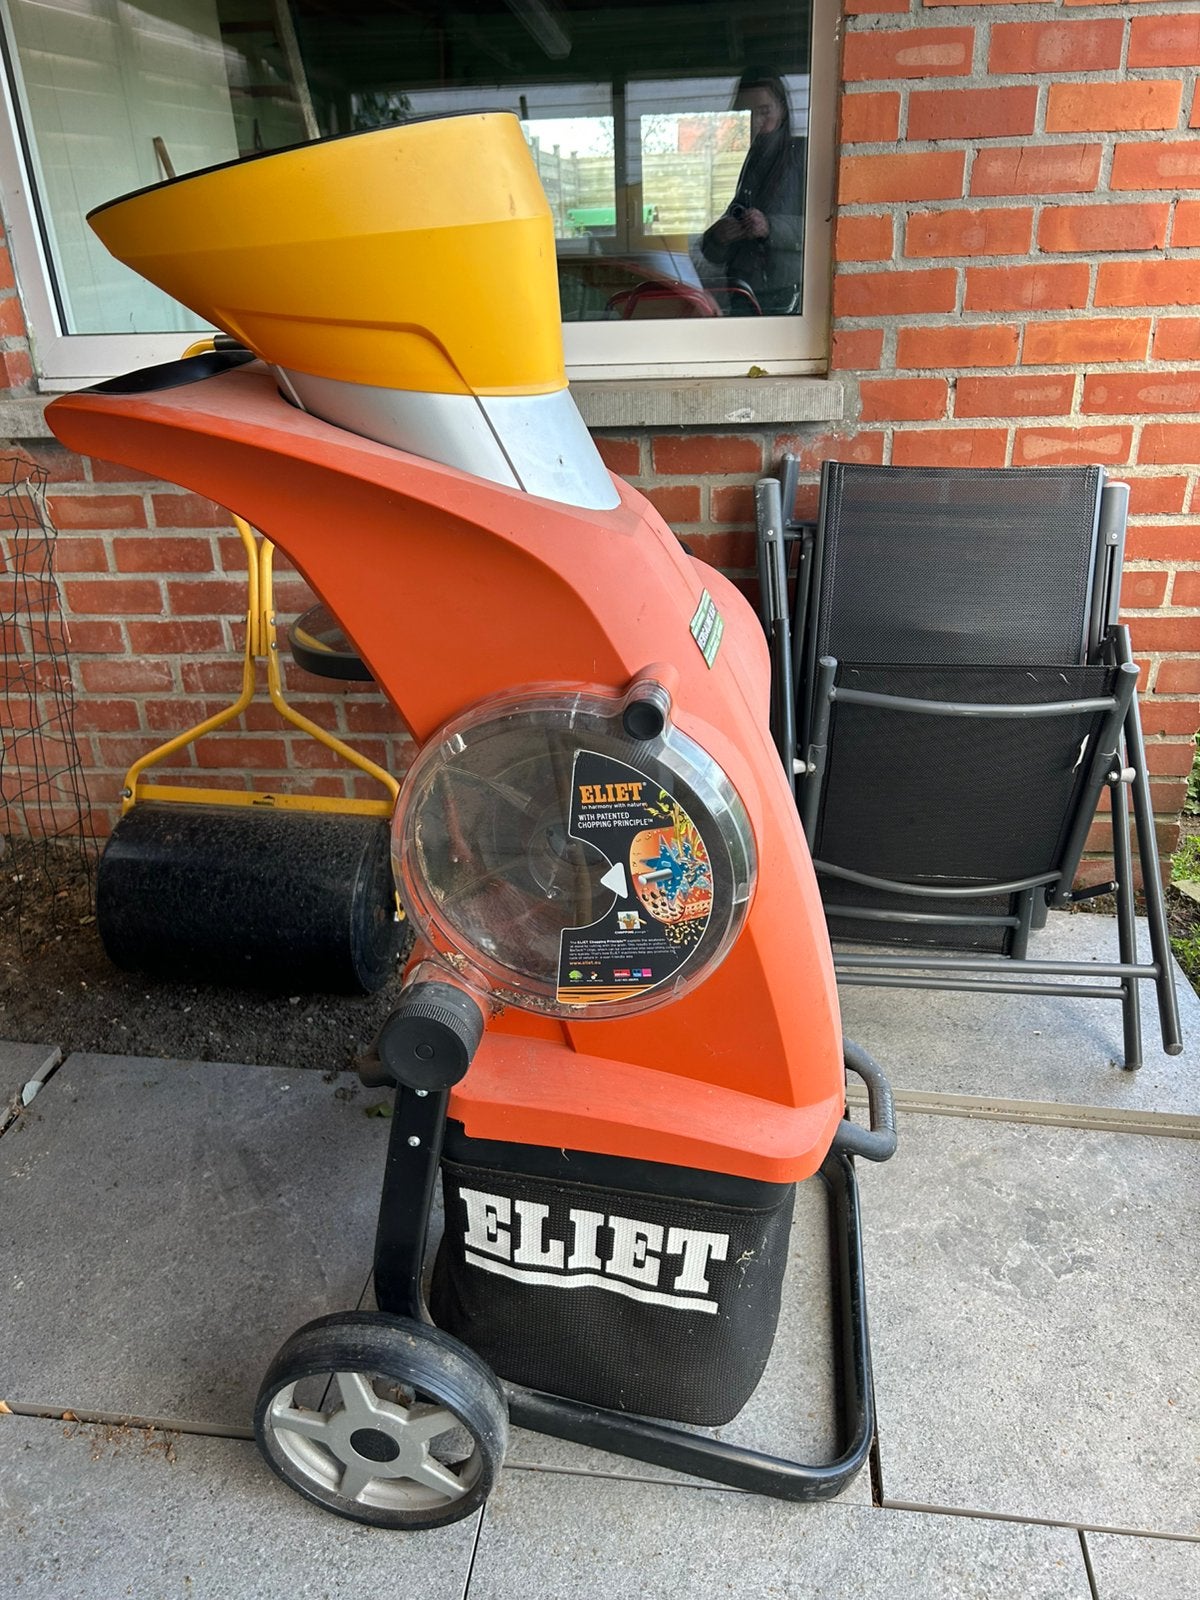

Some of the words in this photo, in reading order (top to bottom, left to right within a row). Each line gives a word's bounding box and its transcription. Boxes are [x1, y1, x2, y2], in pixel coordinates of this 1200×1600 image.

[578, 813, 595, 821] WITH
[596, 812, 630, 820] PATENTED
[577, 820, 612, 829] CHOPPING
[459, 1187, 729, 1293] ELIET
